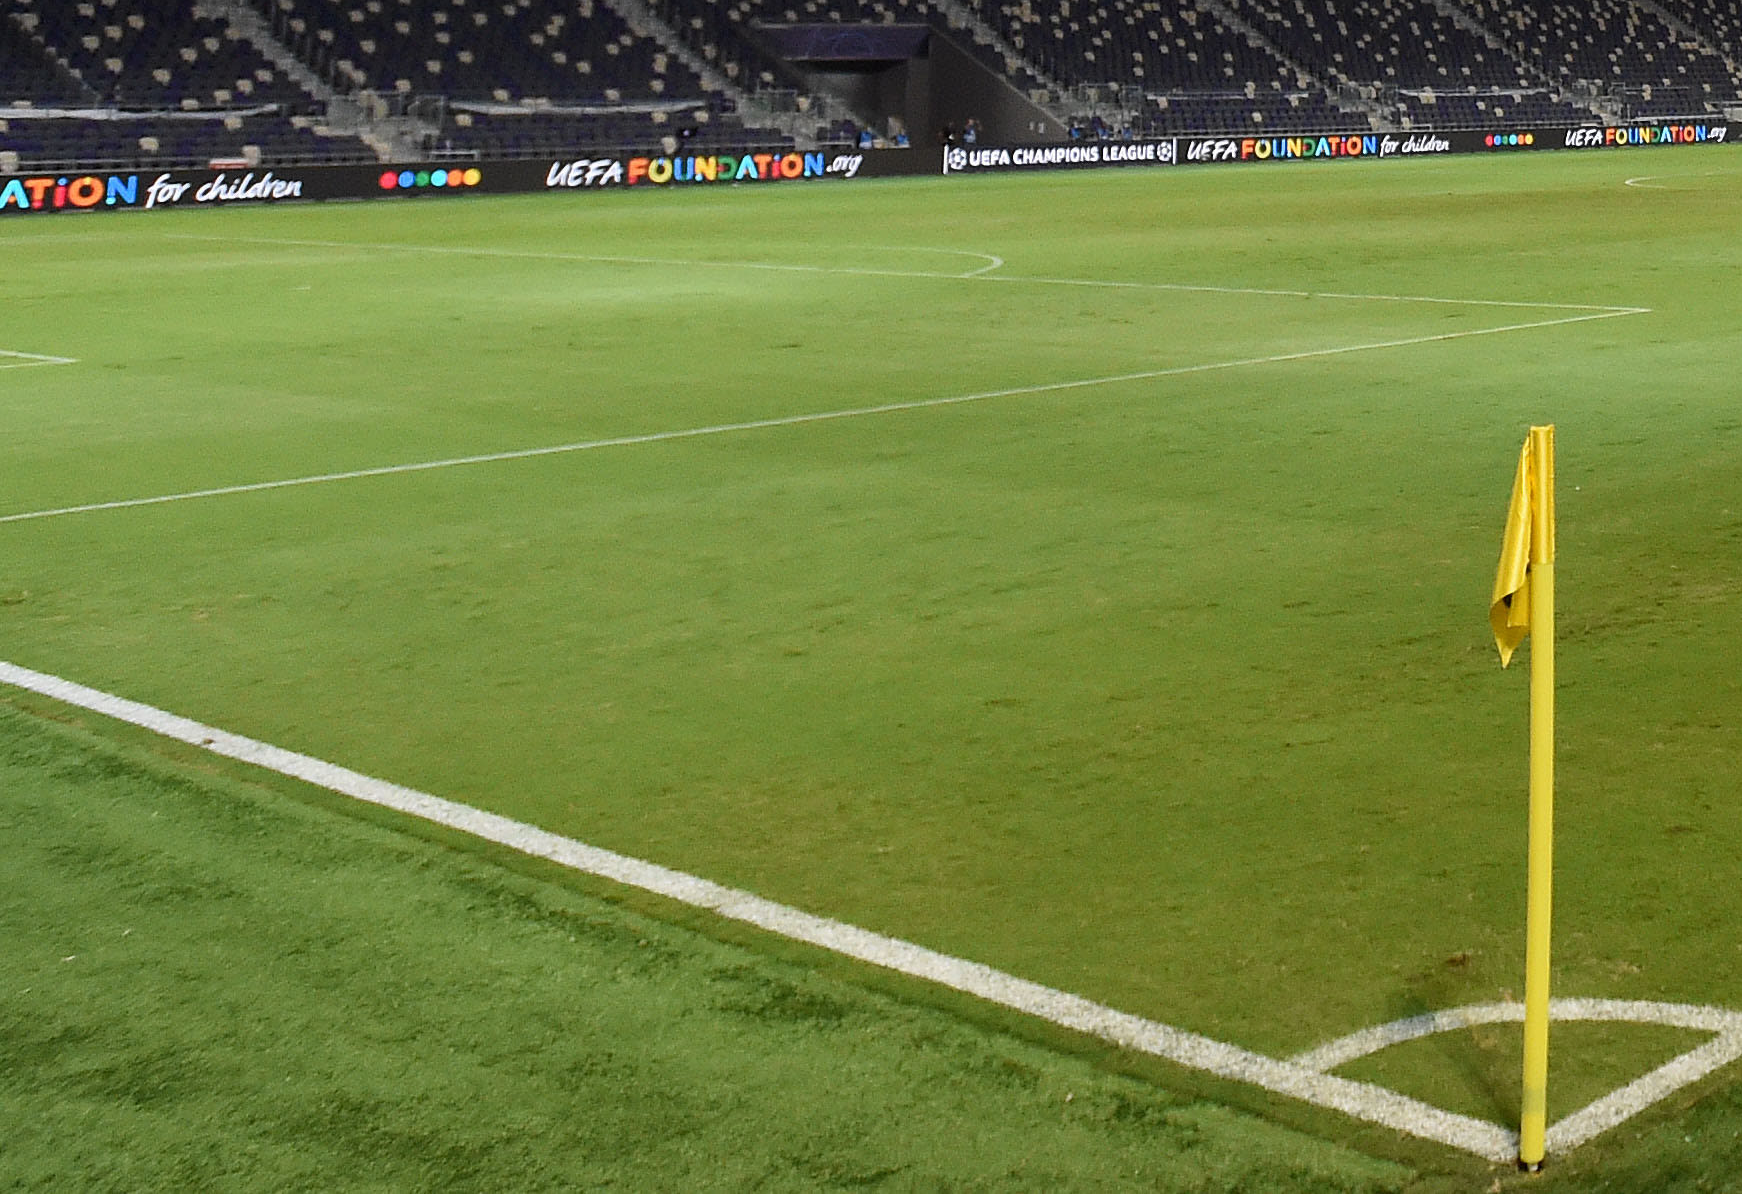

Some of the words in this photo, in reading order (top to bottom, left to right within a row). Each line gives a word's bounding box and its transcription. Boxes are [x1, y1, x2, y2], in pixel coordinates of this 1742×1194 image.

[1187, 140, 1238, 161] UEFA
[1380, 134, 1400, 157] for
[1402, 133, 1450, 153] children
[1565, 127, 1603, 147] UEFA
[969, 149, 1010, 167] UEFA
[1013, 146, 1099, 165] CHAMPIONS
[1102, 143, 1155, 162] LEAGUE
[546, 158, 624, 187] UEFA
[826, 154, 863, 179] .org
[145, 172, 191, 208] for
[194, 171, 303, 203] children
